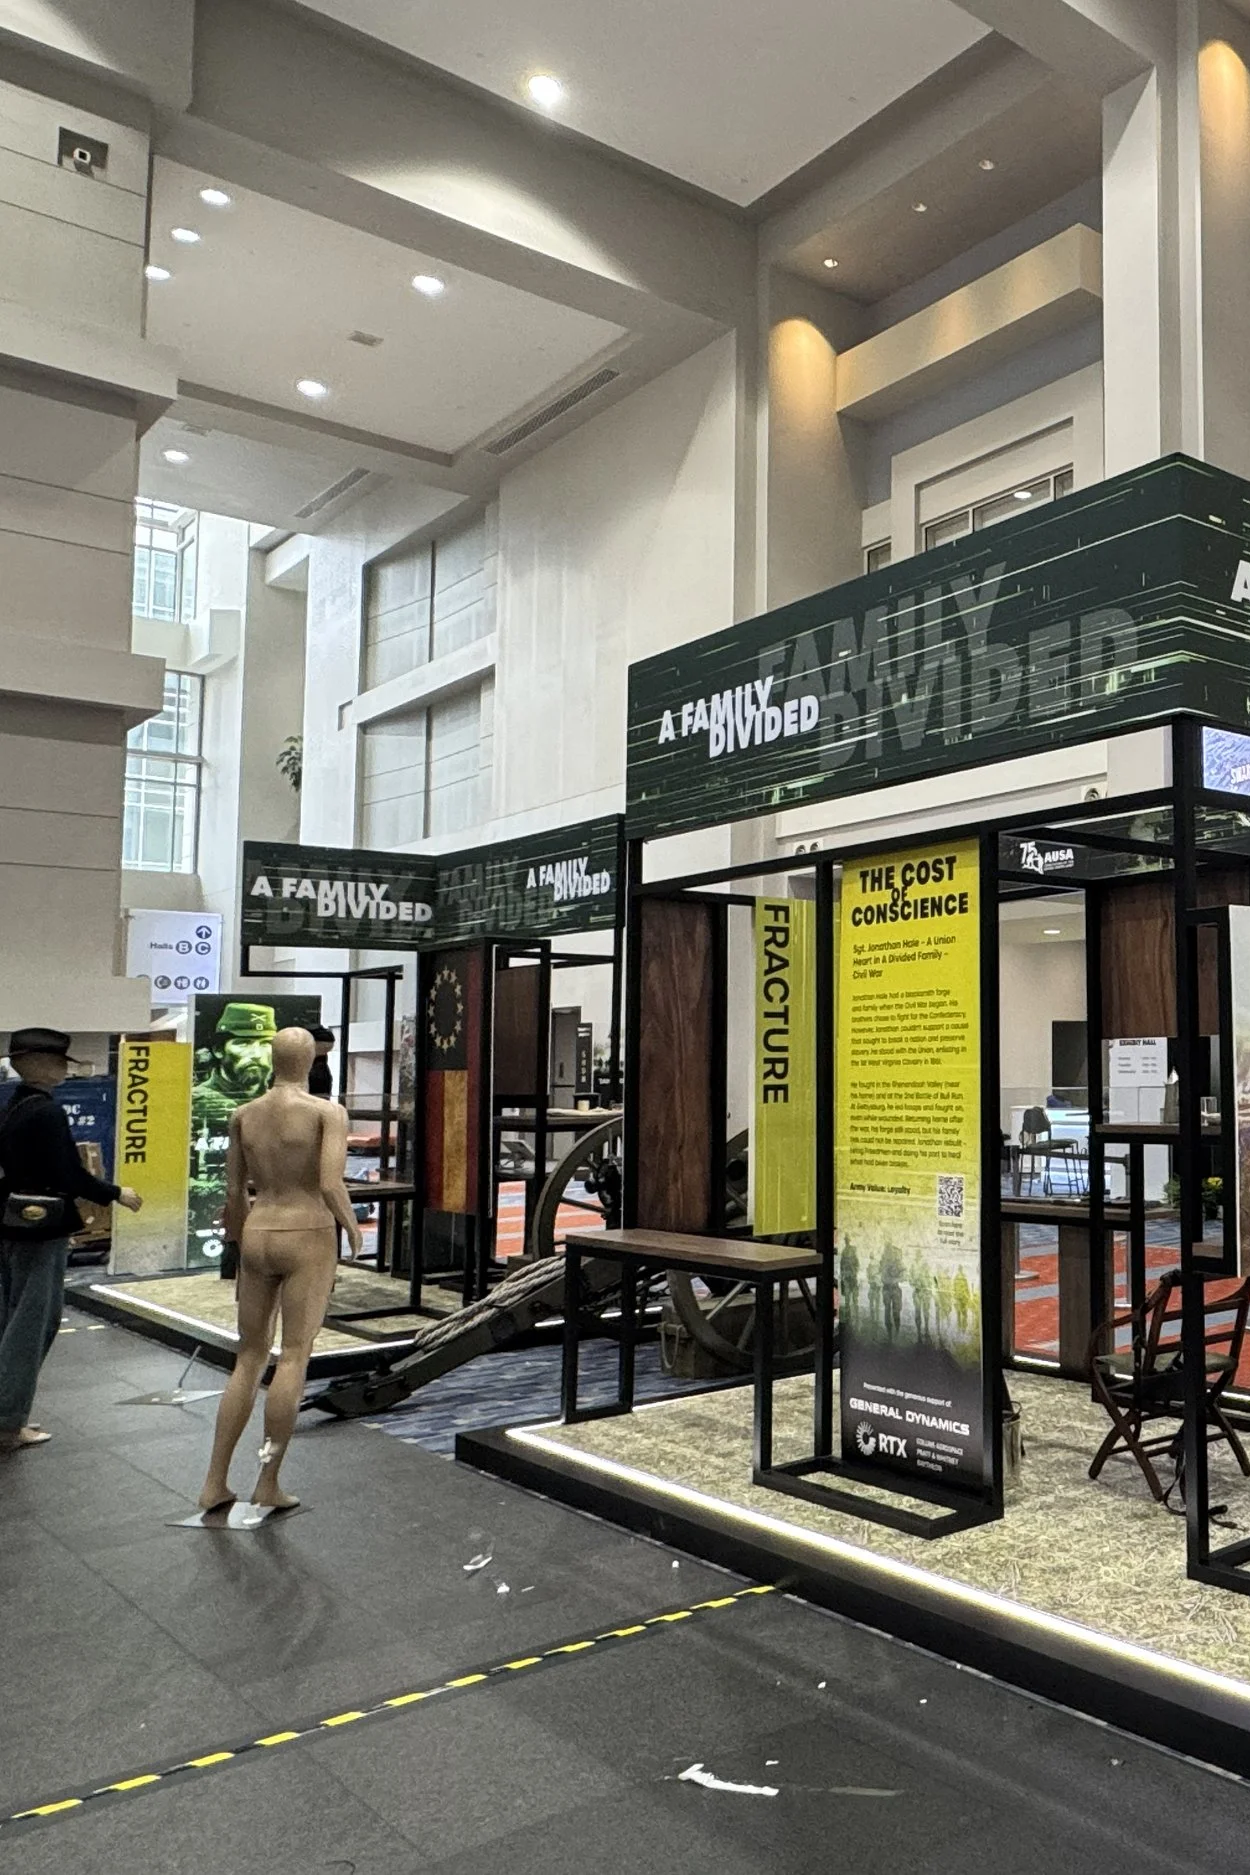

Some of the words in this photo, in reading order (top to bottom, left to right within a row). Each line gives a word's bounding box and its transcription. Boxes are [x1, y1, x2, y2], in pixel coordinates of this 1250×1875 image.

[657, 710, 676, 745] A
[681, 676, 776, 737] FAMILY
[709, 694, 820, 758] DIVIDED
[1020, 841, 1038, 864] 75
[1044, 848, 1074, 864] AUSA
[526, 867, 537, 889] A
[539, 857, 589, 889] FAMILY
[553, 872, 611, 902] DIVIDED
[859, 865, 895, 894] THE
[901, 855, 957, 887] COST
[250, 875, 273, 899] A
[282, 878, 389, 904] FAMILY
[891, 886, 908, 904] OF
[317, 899, 433, 922] DIVIDED
[852, 892, 969, 927] CONSCIENCE
[853, 957, 872, 967] Heart
[881, 955, 887, 964] A
[888, 952, 916, 964] Divided
[918, 949, 942, 961] Family
[867, 941, 901, 953] Jonathan
[926, 937, 932, 946] A
[934, 935, 956, 945] Union
[852, 969, 868, 980] Civil
[868, 969, 883, 978] War
[762, 903, 790, 1105] FRACTURE
[124, 1045, 151, 1165] FRACTURE
[850, 1182, 865, 1192] Army
[849, 1397, 903, 1420] GENERAL
[905, 1410, 970, 1437] DYNAMICS
[878, 1433, 908, 1459] RTX
